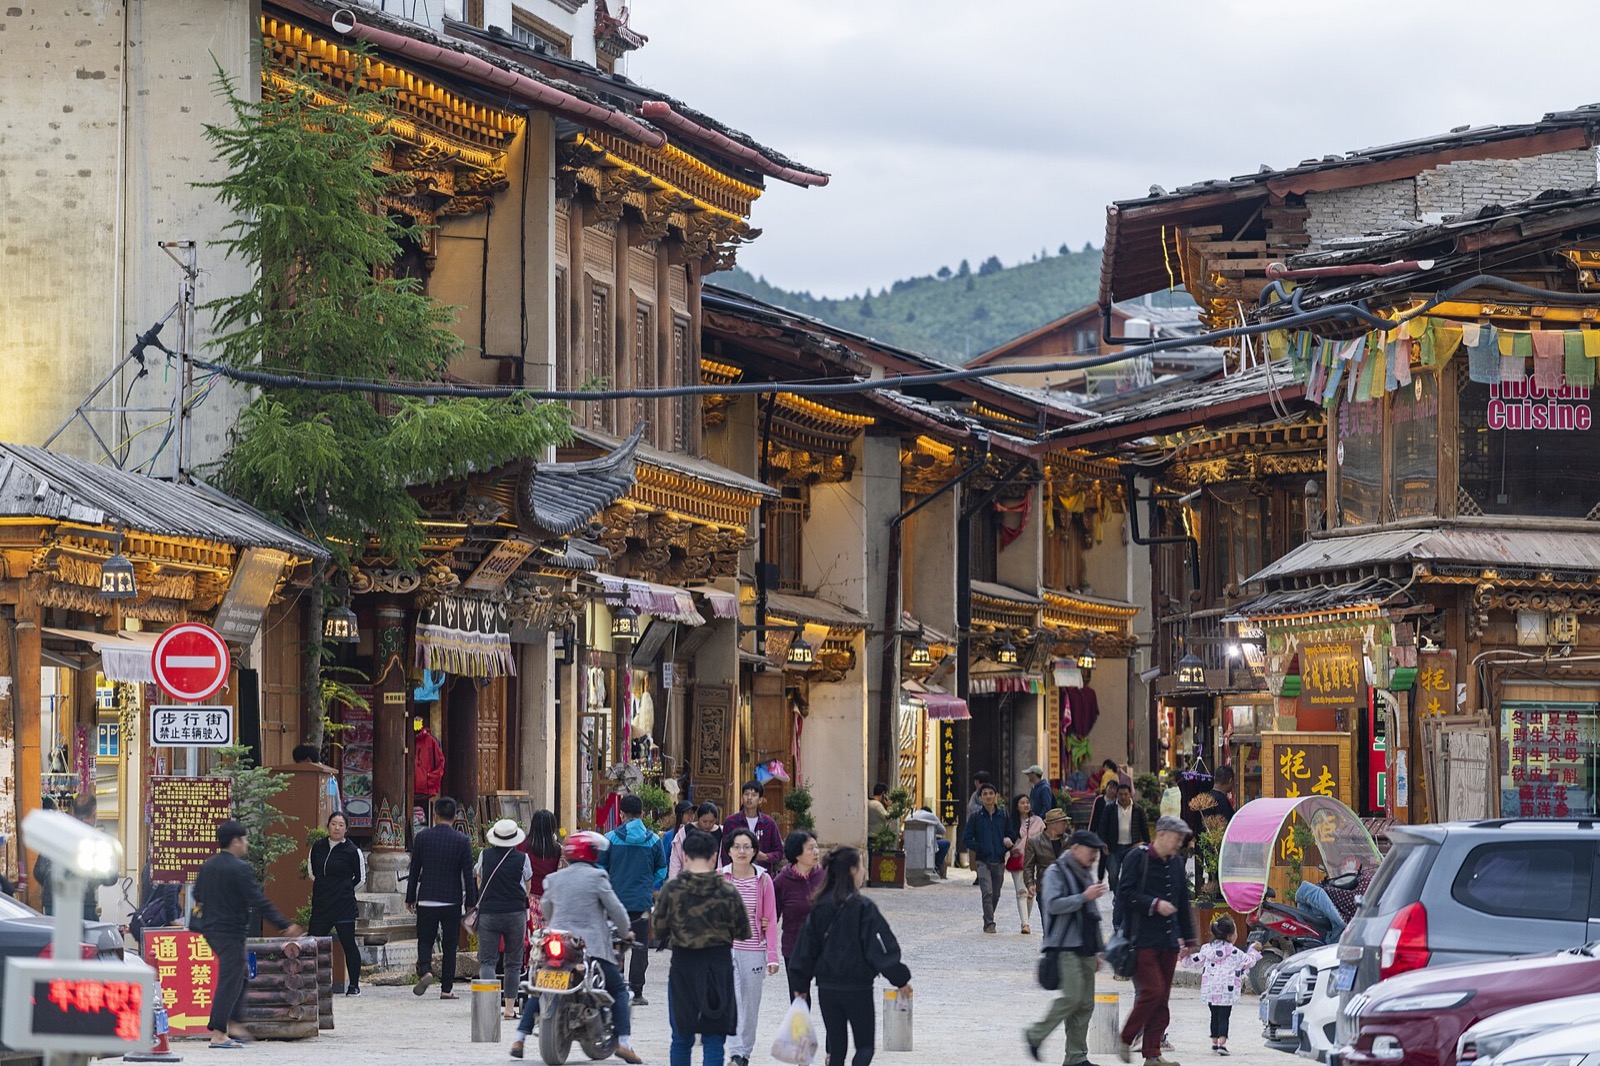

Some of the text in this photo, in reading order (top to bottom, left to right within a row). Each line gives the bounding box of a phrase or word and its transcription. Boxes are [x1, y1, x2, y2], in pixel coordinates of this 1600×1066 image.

[1486, 369, 1590, 400] Tibetan
[1487, 399, 1592, 431] Cuisine
[161, 712, 222, 726] 步行街
[1511, 709, 1580, 726] 冬虫夏草
[160, 726, 223, 740] 禁止车辆驶入
[1513, 726, 1579, 743] 野生天麻
[1511, 747, 1579, 763] 野生贝母
[1511, 766, 1578, 784] 铁皮石斛
[1518, 784, 1568, 801] 藏红花
[152, 934, 214, 961] 通道
[158, 964, 212, 985] 严禁
[161, 987, 212, 1009] 停车
